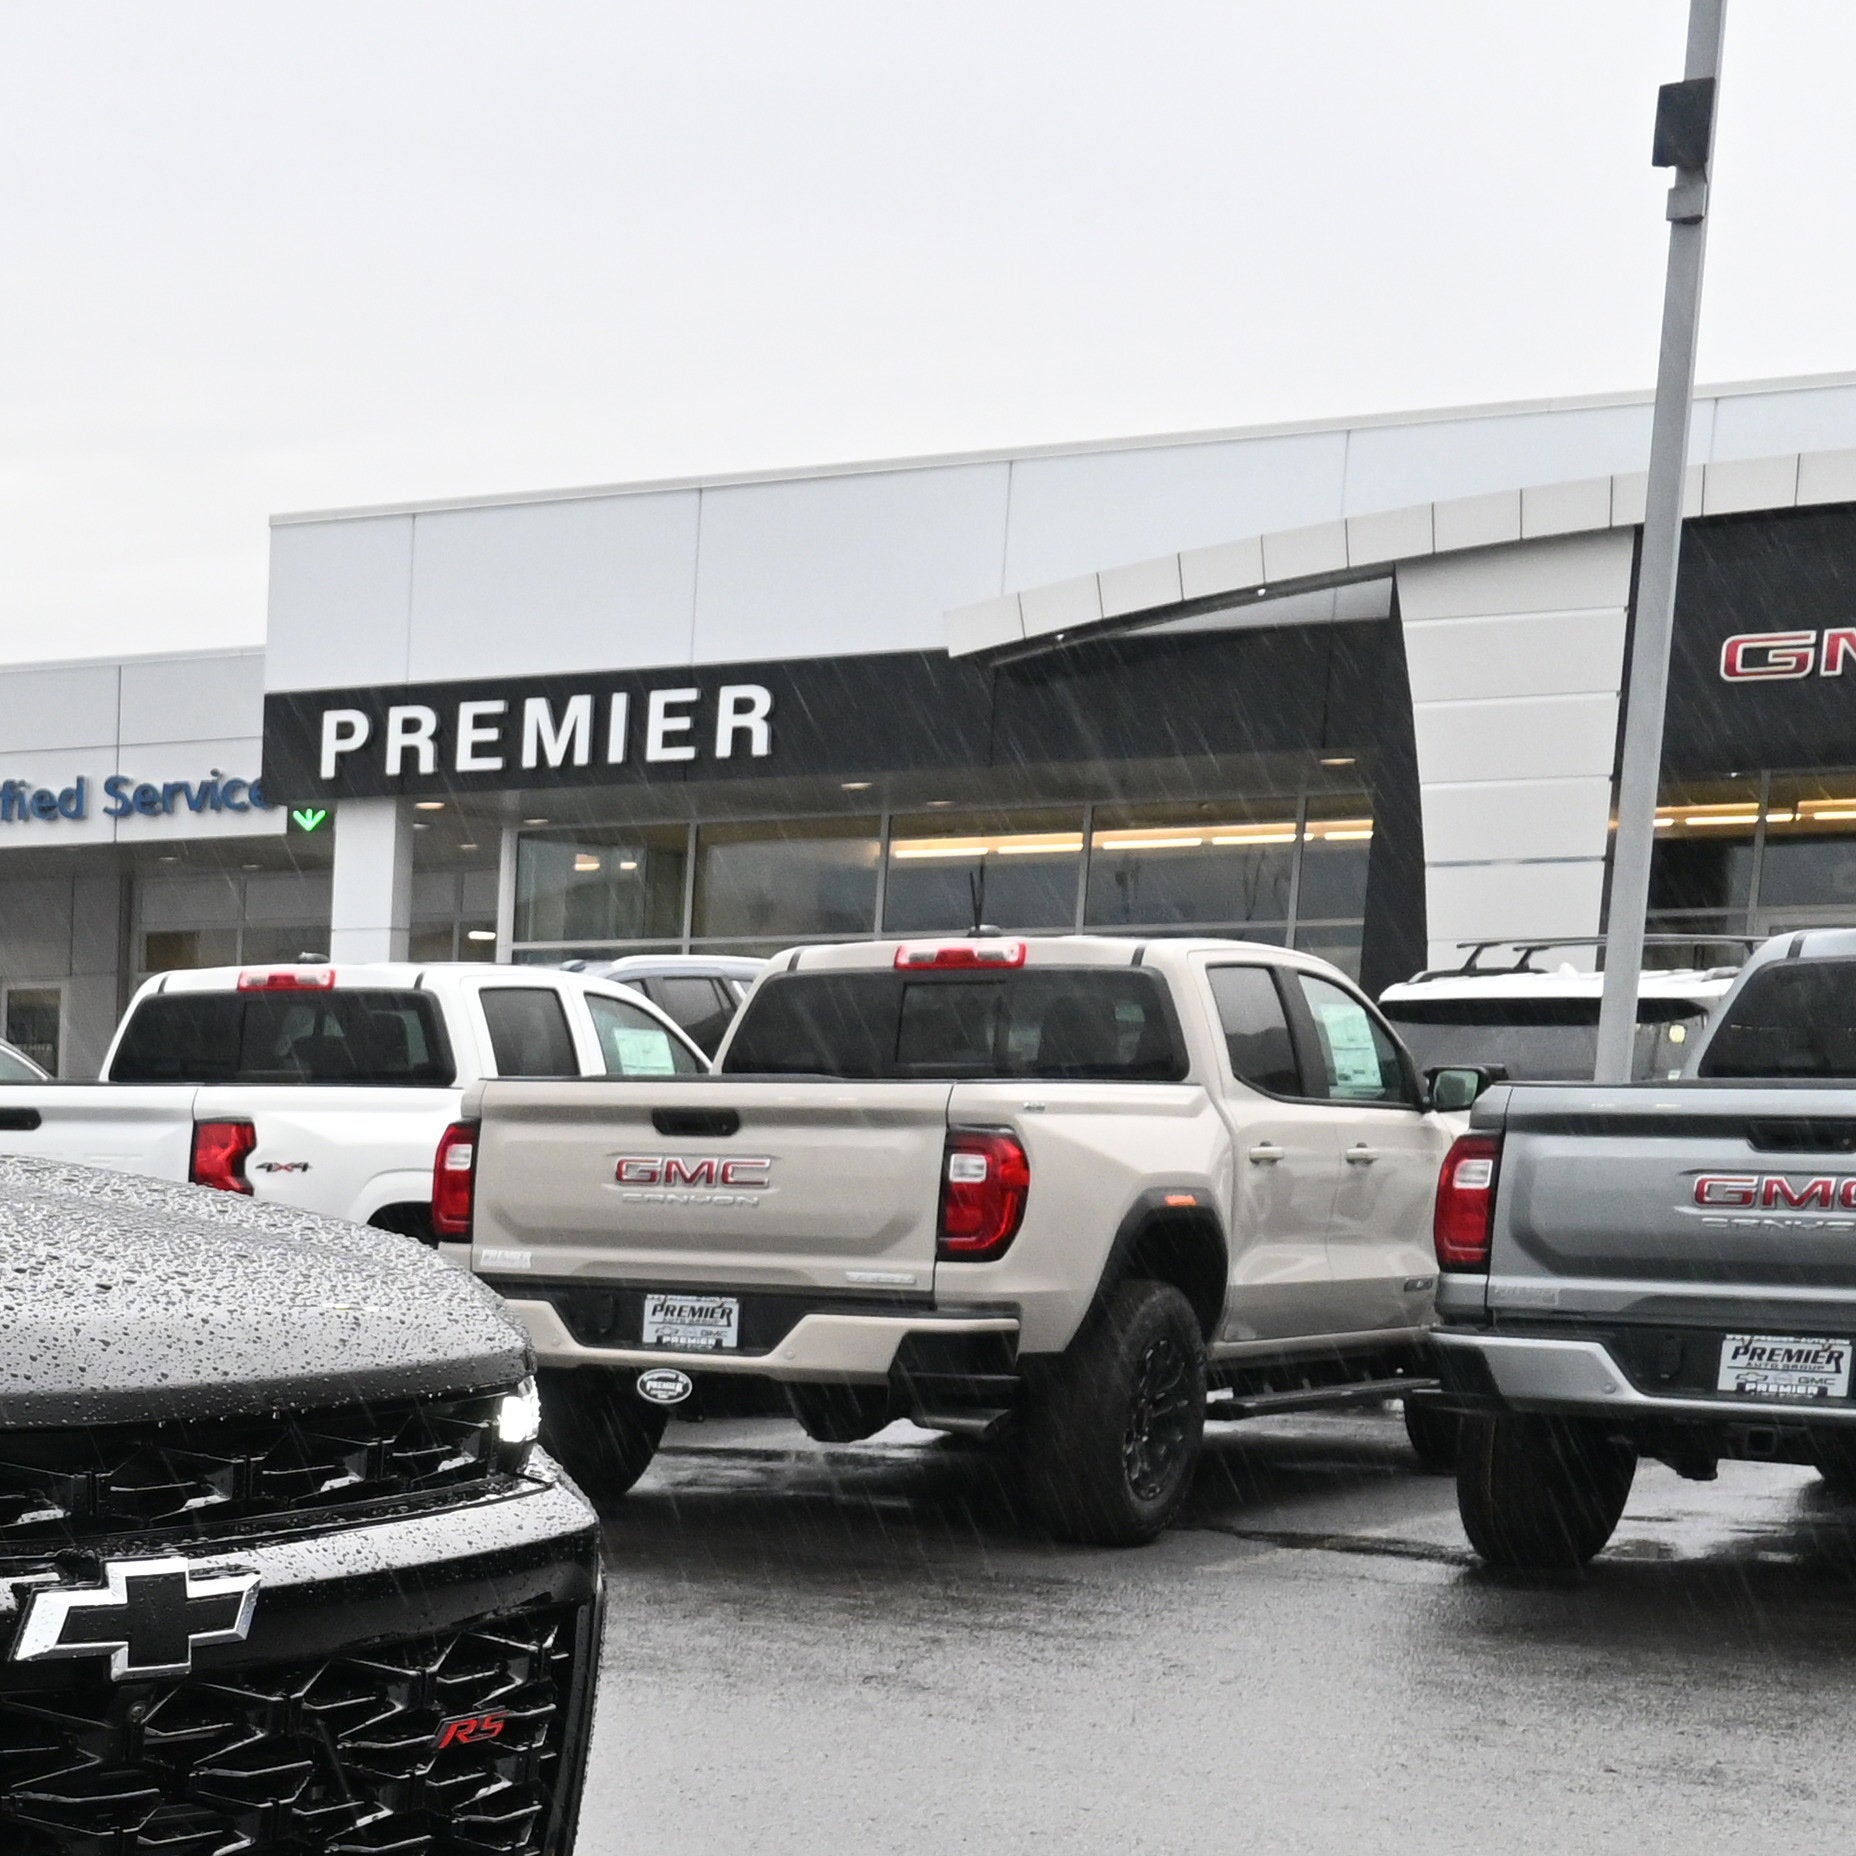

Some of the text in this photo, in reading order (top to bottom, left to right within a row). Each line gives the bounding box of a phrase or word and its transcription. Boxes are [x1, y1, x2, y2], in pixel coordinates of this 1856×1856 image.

[319, 684, 774, 780] PREMIER
[615, 1156, 771, 1188] GMC
[1694, 1174, 1856, 1210] GM
[651, 1303, 733, 1327] PREMIER
[1731, 1345, 1844, 1373] PREMIER
[1745, 1382, 1819, 1396] PREMIER
[1798, 1376, 1836, 1386] GMC
[438, 1709, 510, 1749] RS
